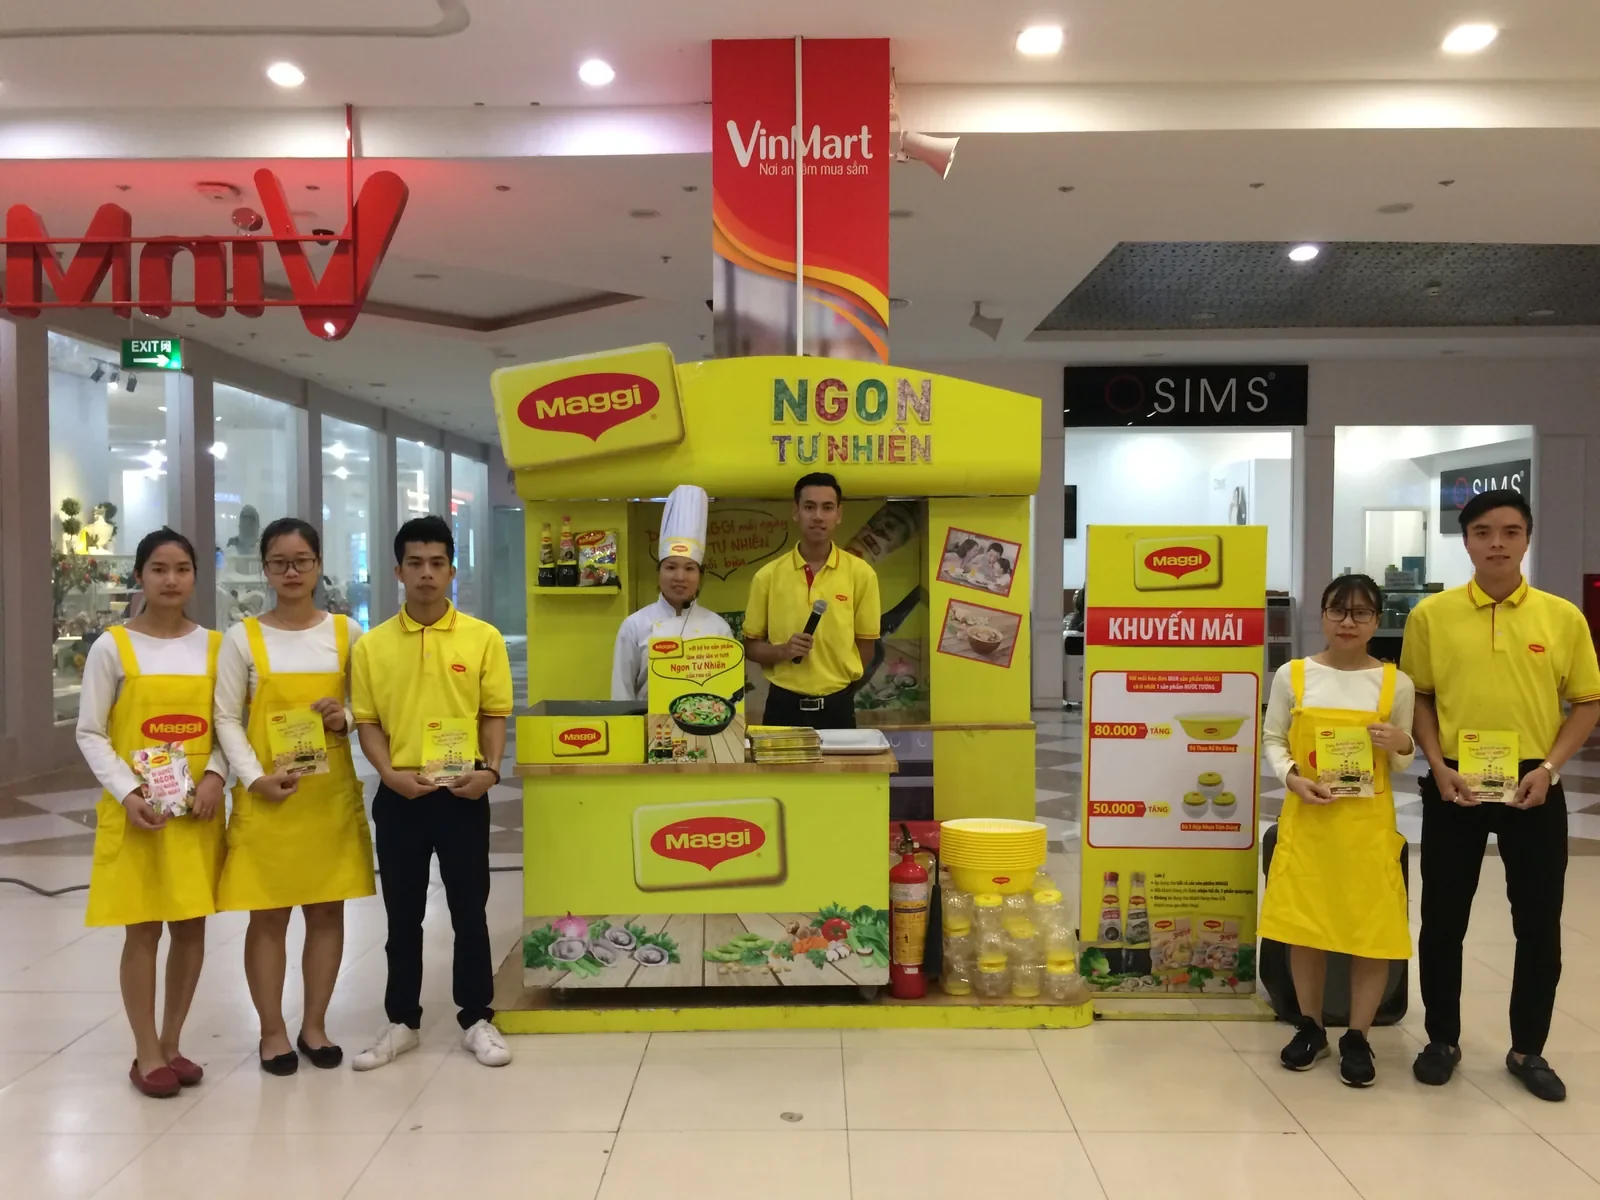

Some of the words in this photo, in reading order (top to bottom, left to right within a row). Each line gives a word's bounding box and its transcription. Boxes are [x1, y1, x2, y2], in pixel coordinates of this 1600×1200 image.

[727, 120, 873, 167] VinMart
[760, 163, 778, 175] Nơi
[781, 166, 794, 175] an
[801, 163, 817, 175] âm
[821, 165, 843, 175] mua
[131, 341, 159, 352] EXIT
[536, 385, 642, 420] Maggi
[772, 377, 932, 424] NGON
[826, 424, 932, 465] NHIÊN
[1153, 554, 1202, 566] Maggi
[1109, 610, 1194, 640] KHUYẾN
[1201, 612, 1243, 640] MÃI
[671, 664, 689, 673] Ngon
[150, 722, 202, 734] Maggi
[1094, 724, 1137, 736] 80.000
[564, 733, 596, 741] Maggi
[1093, 803, 1136, 814] 50.000
[665, 828, 750, 850] Maggi
